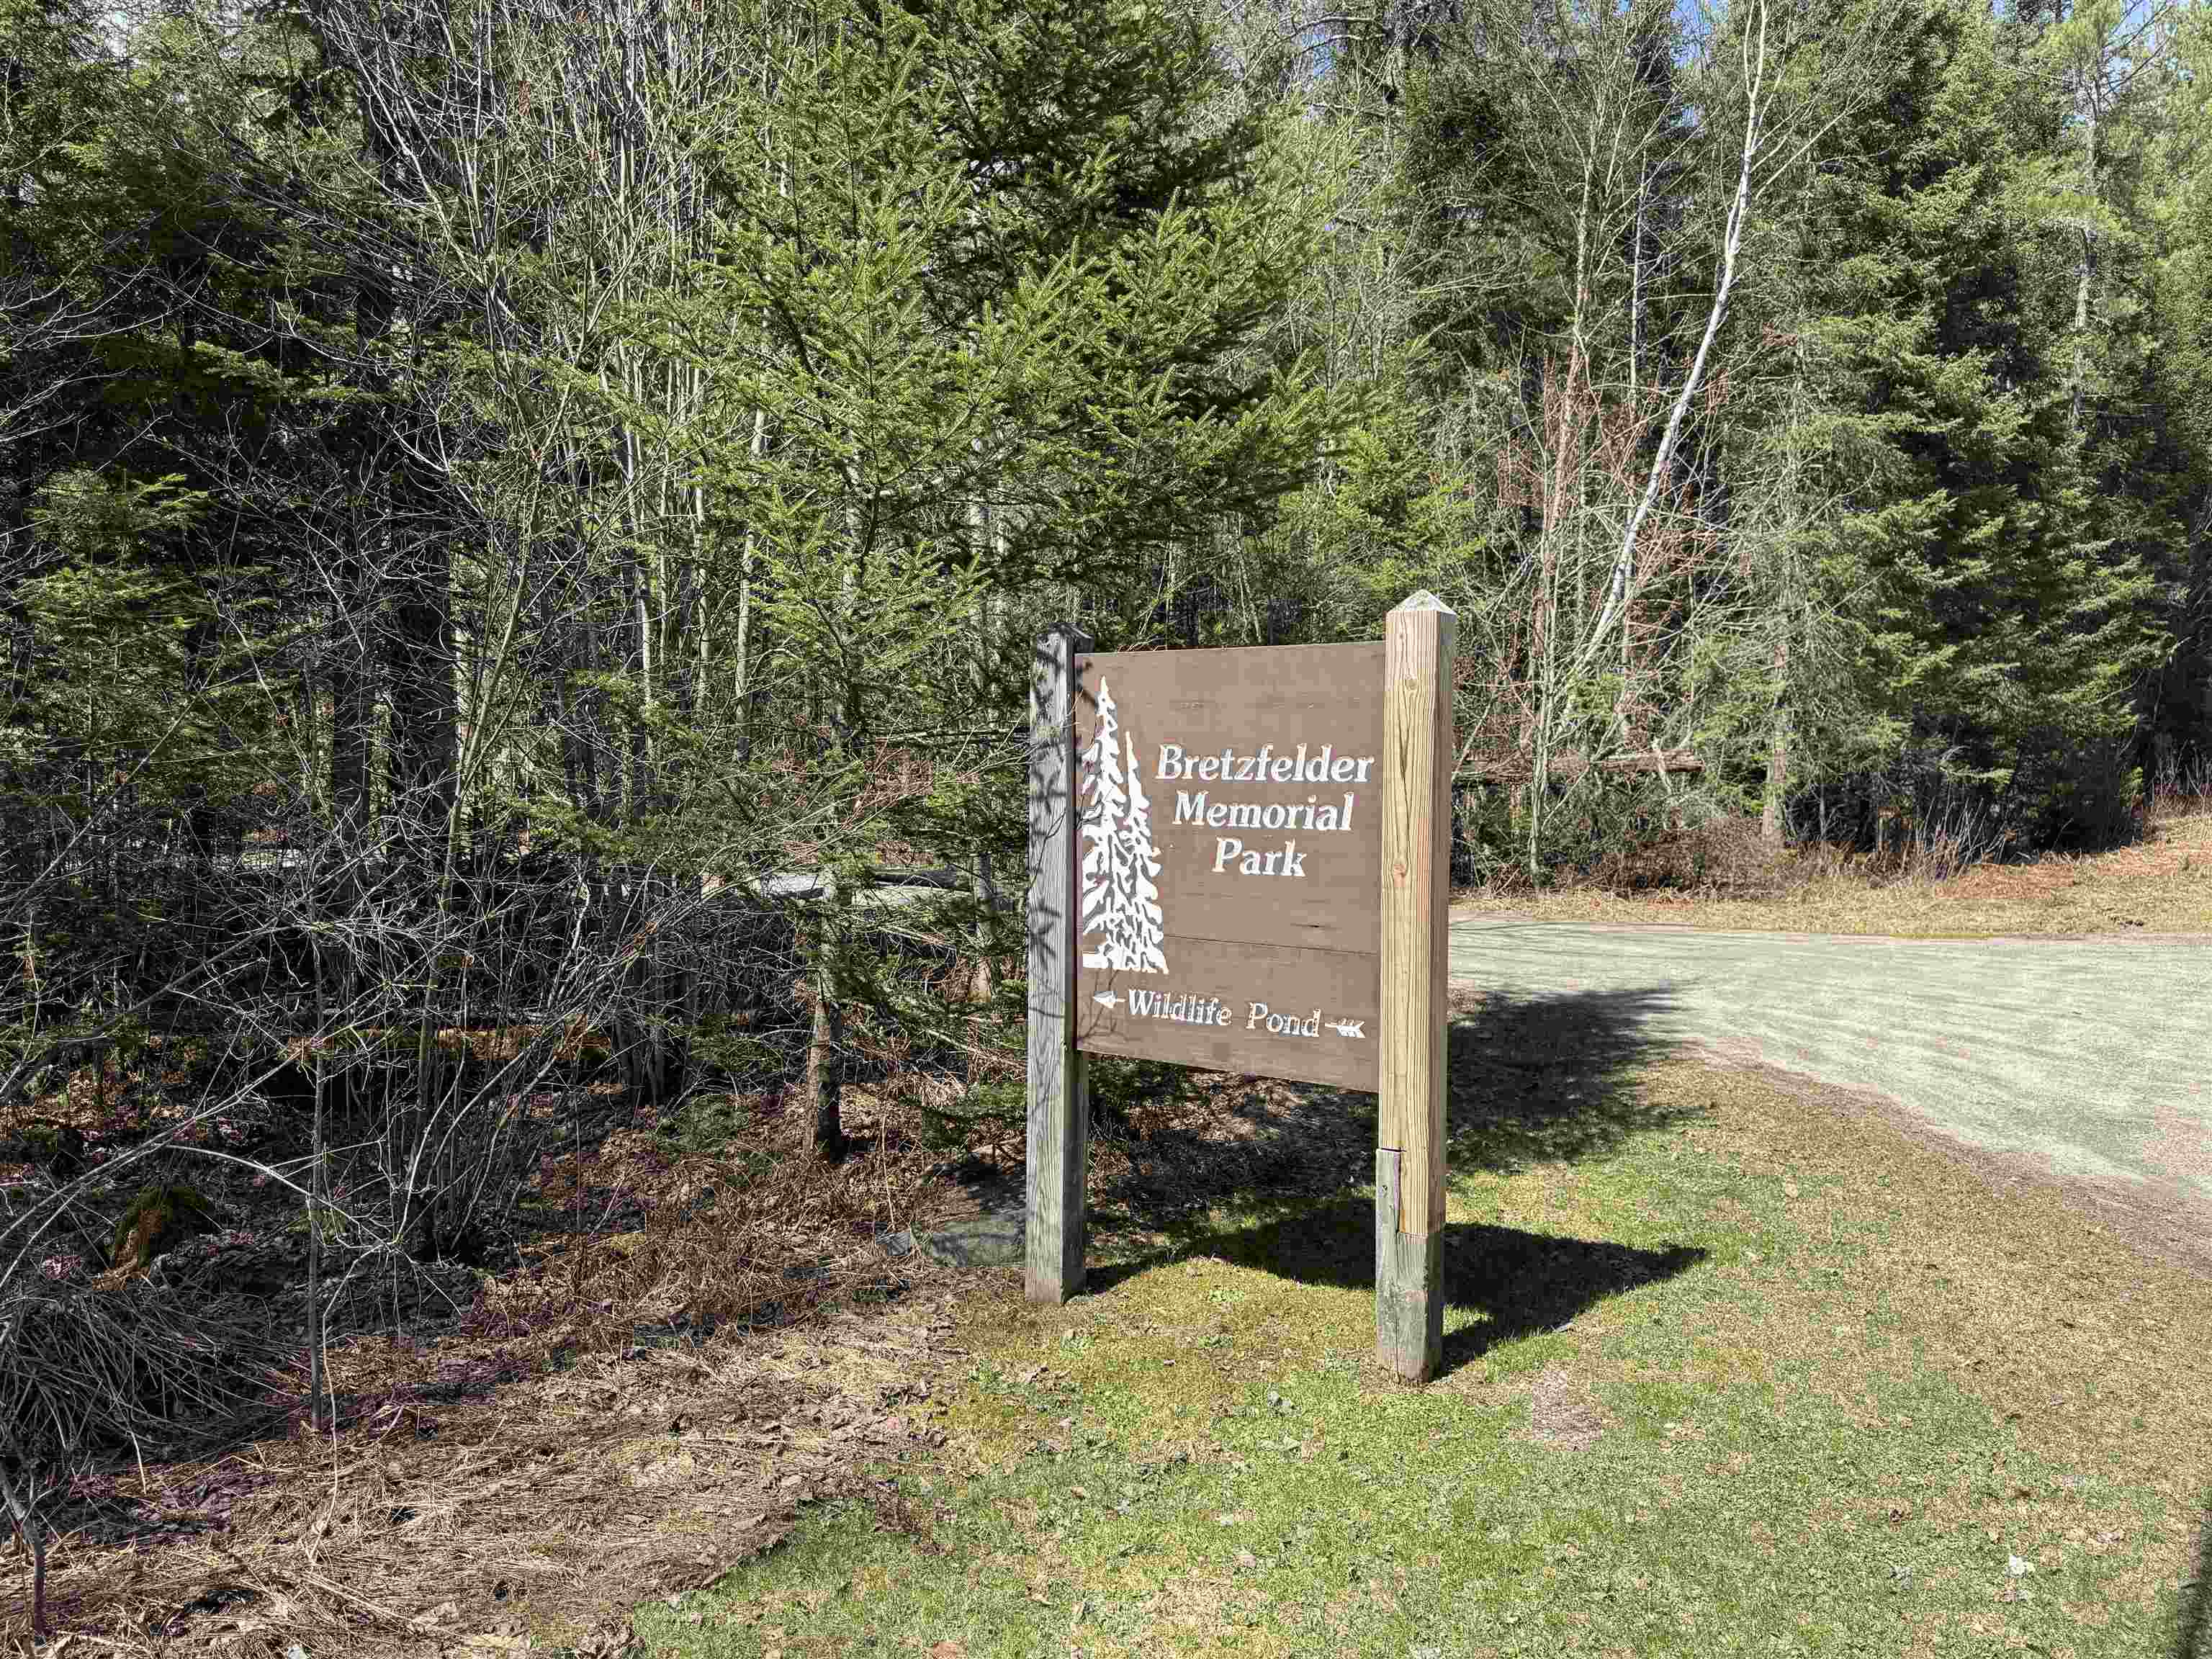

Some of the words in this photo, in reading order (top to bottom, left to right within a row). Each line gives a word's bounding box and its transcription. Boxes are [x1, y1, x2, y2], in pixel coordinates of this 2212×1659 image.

[1155, 742, 1375, 783] Bretzfelder
[1172, 790, 1354, 832] Memorial
[1211, 837, 1308, 877] Park
[1128, 989, 1233, 1027] Wildlife
[1245, 1002, 1321, 1038] Pond
